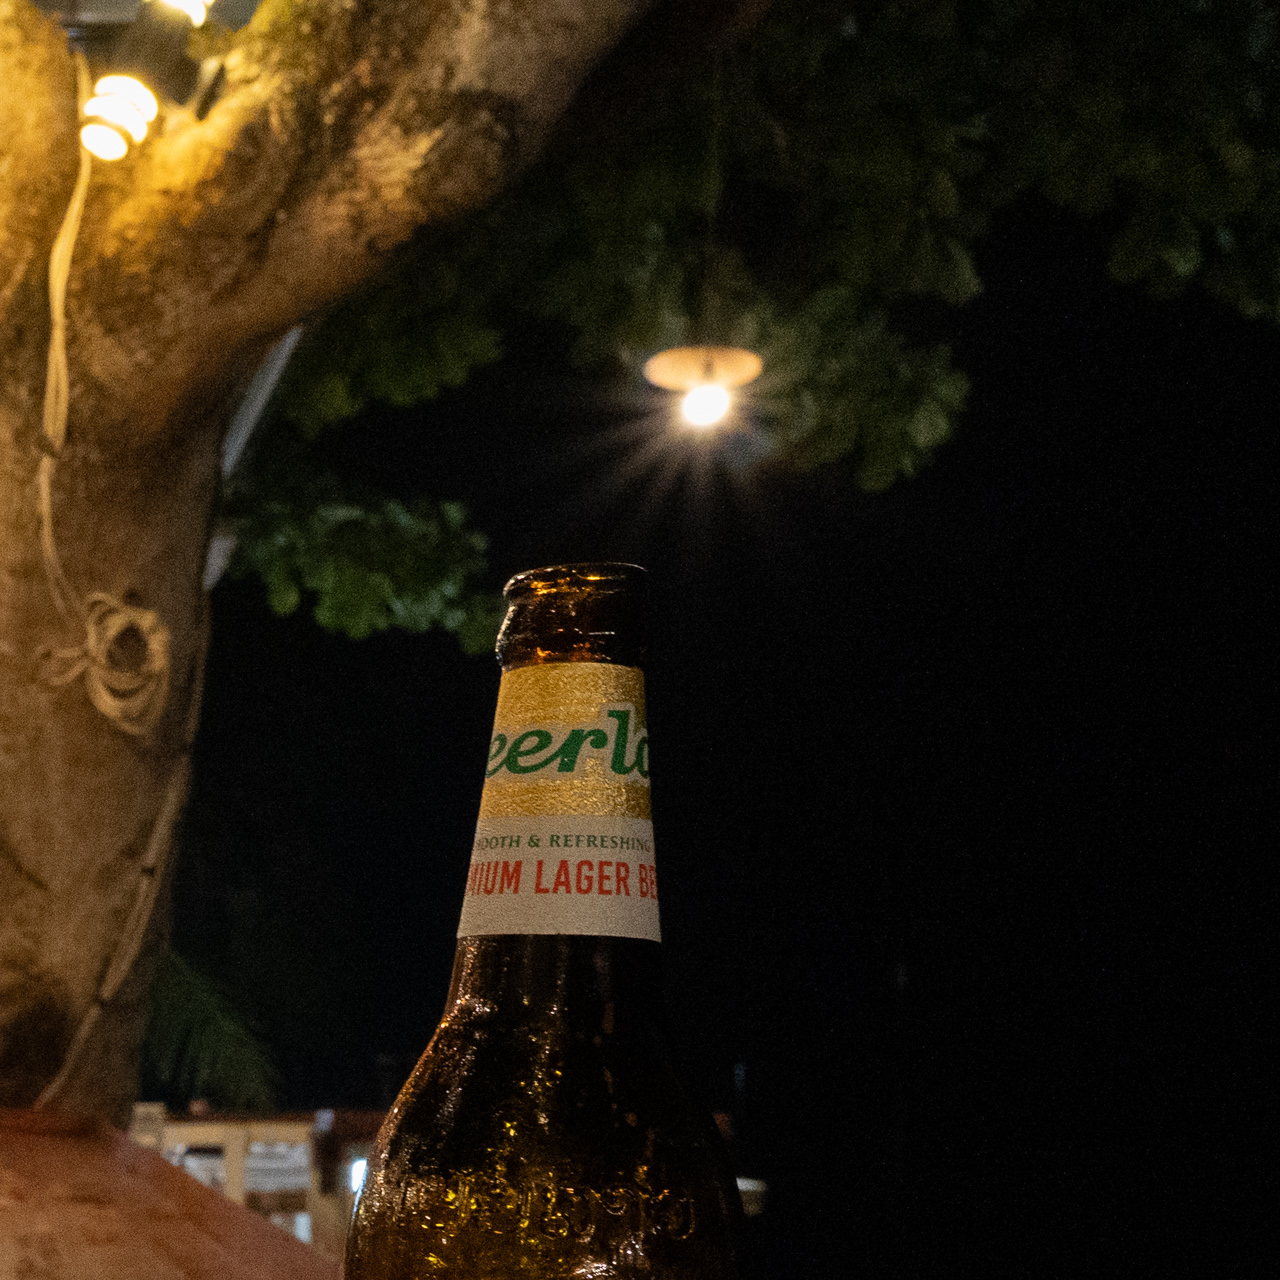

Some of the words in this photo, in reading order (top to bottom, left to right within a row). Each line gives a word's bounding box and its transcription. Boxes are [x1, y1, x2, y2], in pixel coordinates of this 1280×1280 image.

[528, 834, 540, 848] &
[549, 834, 651, 853] REFRESHING
[534, 859, 631, 896] LAGER
